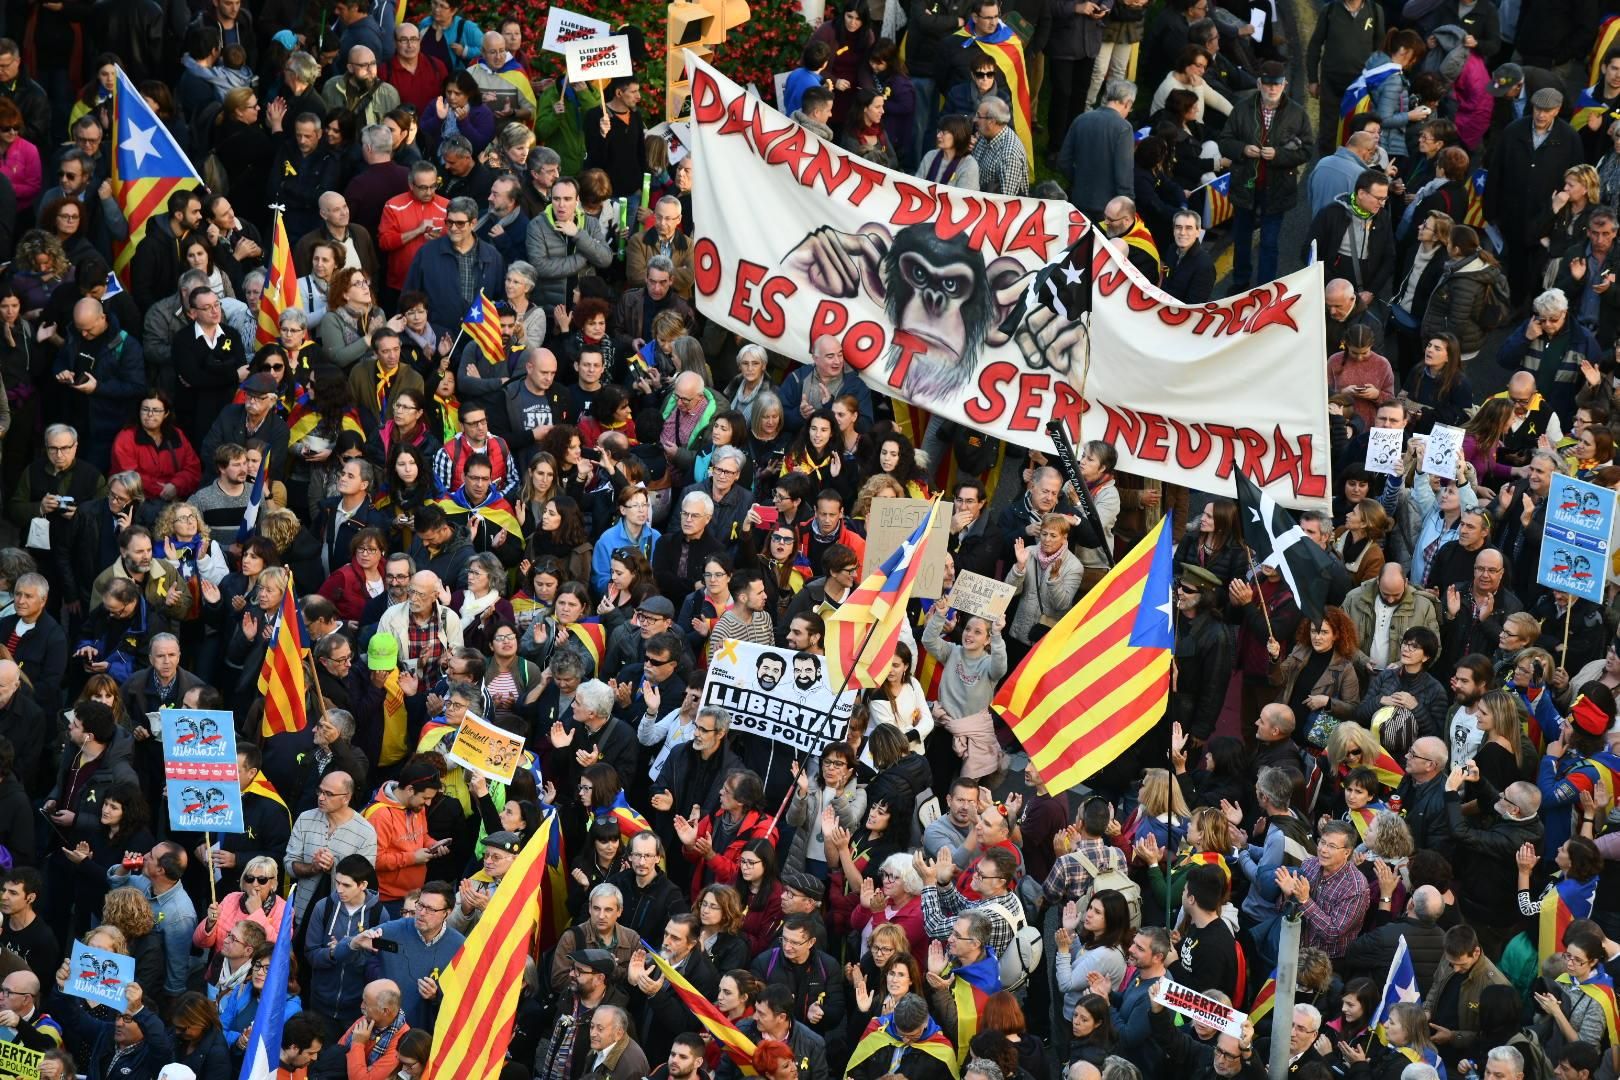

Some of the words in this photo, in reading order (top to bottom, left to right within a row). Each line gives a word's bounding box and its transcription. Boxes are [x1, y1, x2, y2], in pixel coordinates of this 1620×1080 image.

[580, 52, 617, 62] PRESOS
[691, 66, 889, 207] DAVANT
[889, 181, 1059, 264] D'UNA
[728, 259, 798, 338] ES
[809, 299, 928, 389] POT
[963, 361, 1091, 446] SER
[1096, 398, 1327, 499] NEUTRAL
[709, 684, 848, 741] LLIBERTAT
[1165, 994, 1192, 1011] PRESOS
[1167, 982, 1233, 1019] LLIBERTAT
